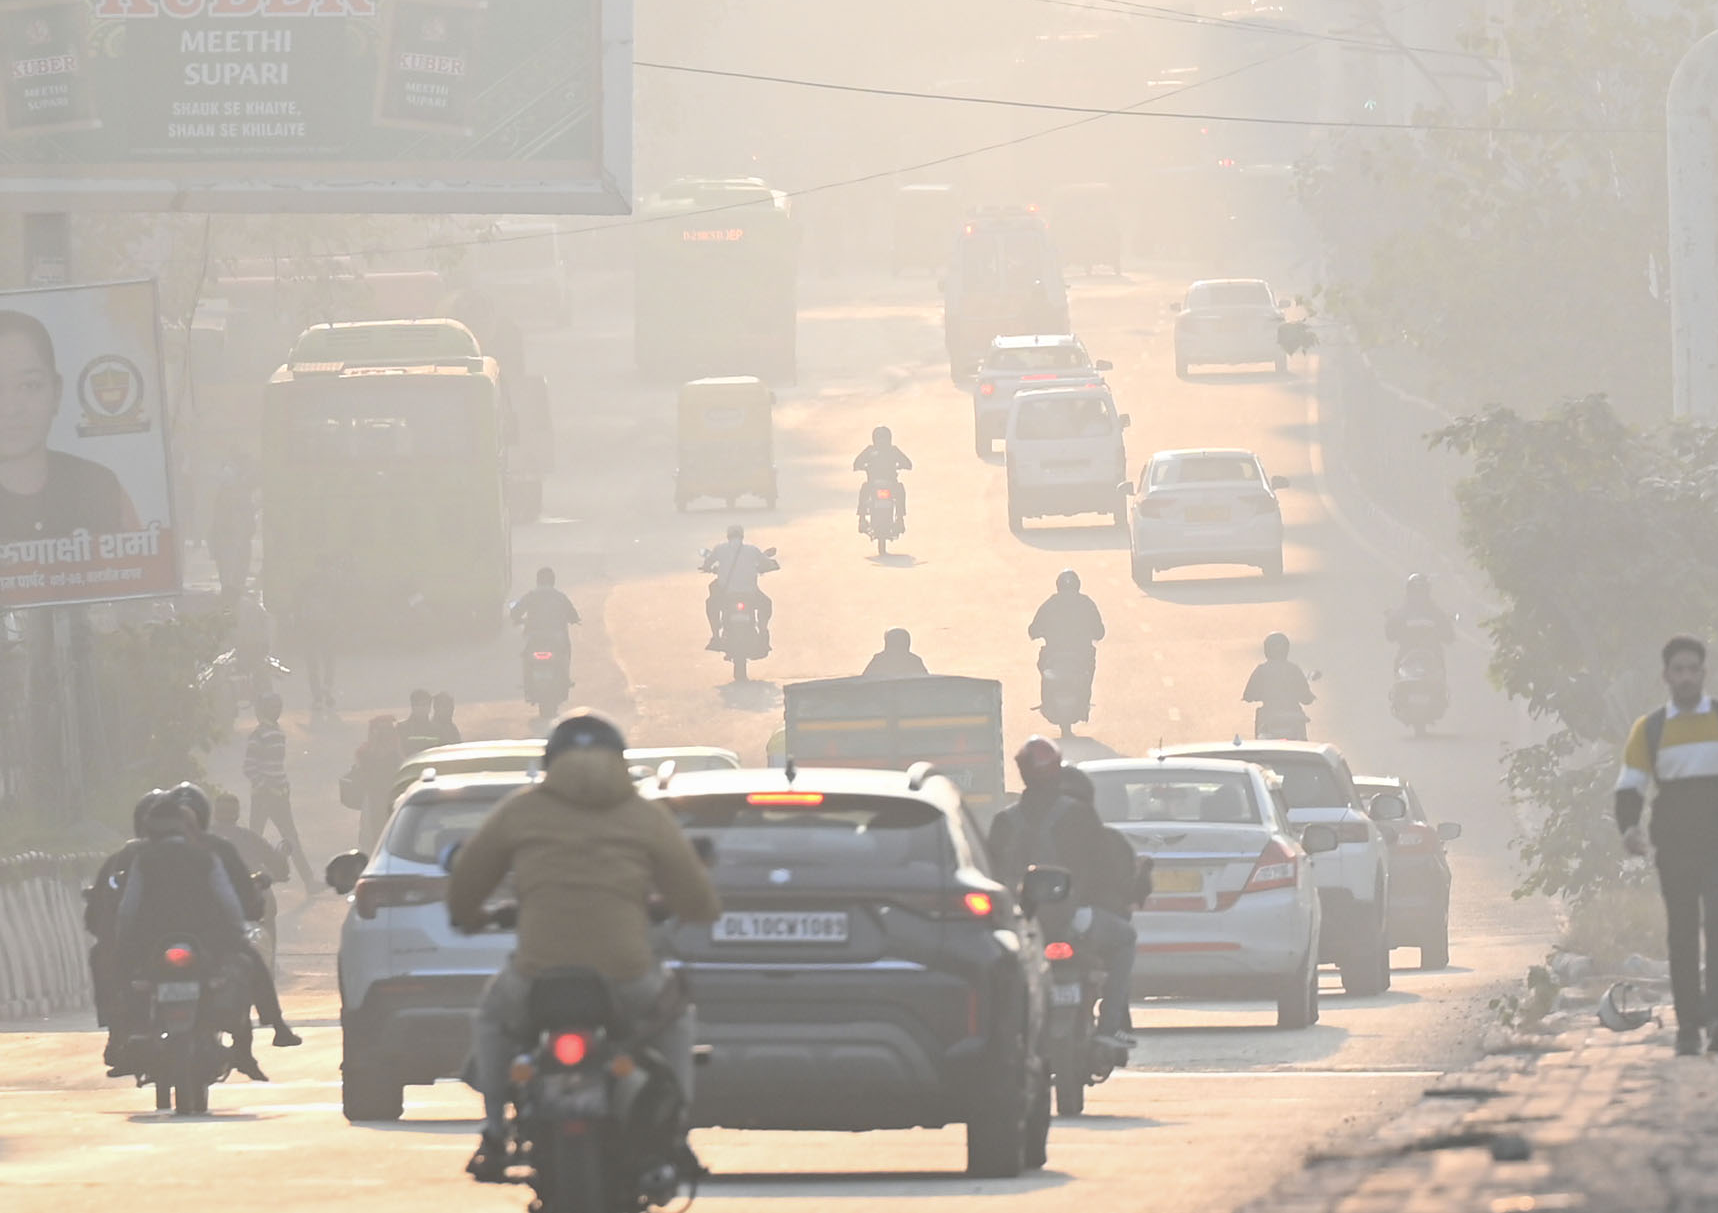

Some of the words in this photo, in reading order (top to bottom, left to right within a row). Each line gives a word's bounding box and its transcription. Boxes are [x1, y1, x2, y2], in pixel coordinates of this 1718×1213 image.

[180, 29, 292, 53] MEETHI
[184, 62, 289, 85] SUPARI
[223, 100, 241, 116] SE
[245, 100, 302, 116] KHAIYE,
[167, 123, 216, 138] SHAAN
[219, 123, 240, 138] SE
[242, 122, 305, 138] KHILAIYE
[98, 522, 160, 559] शर्मा
